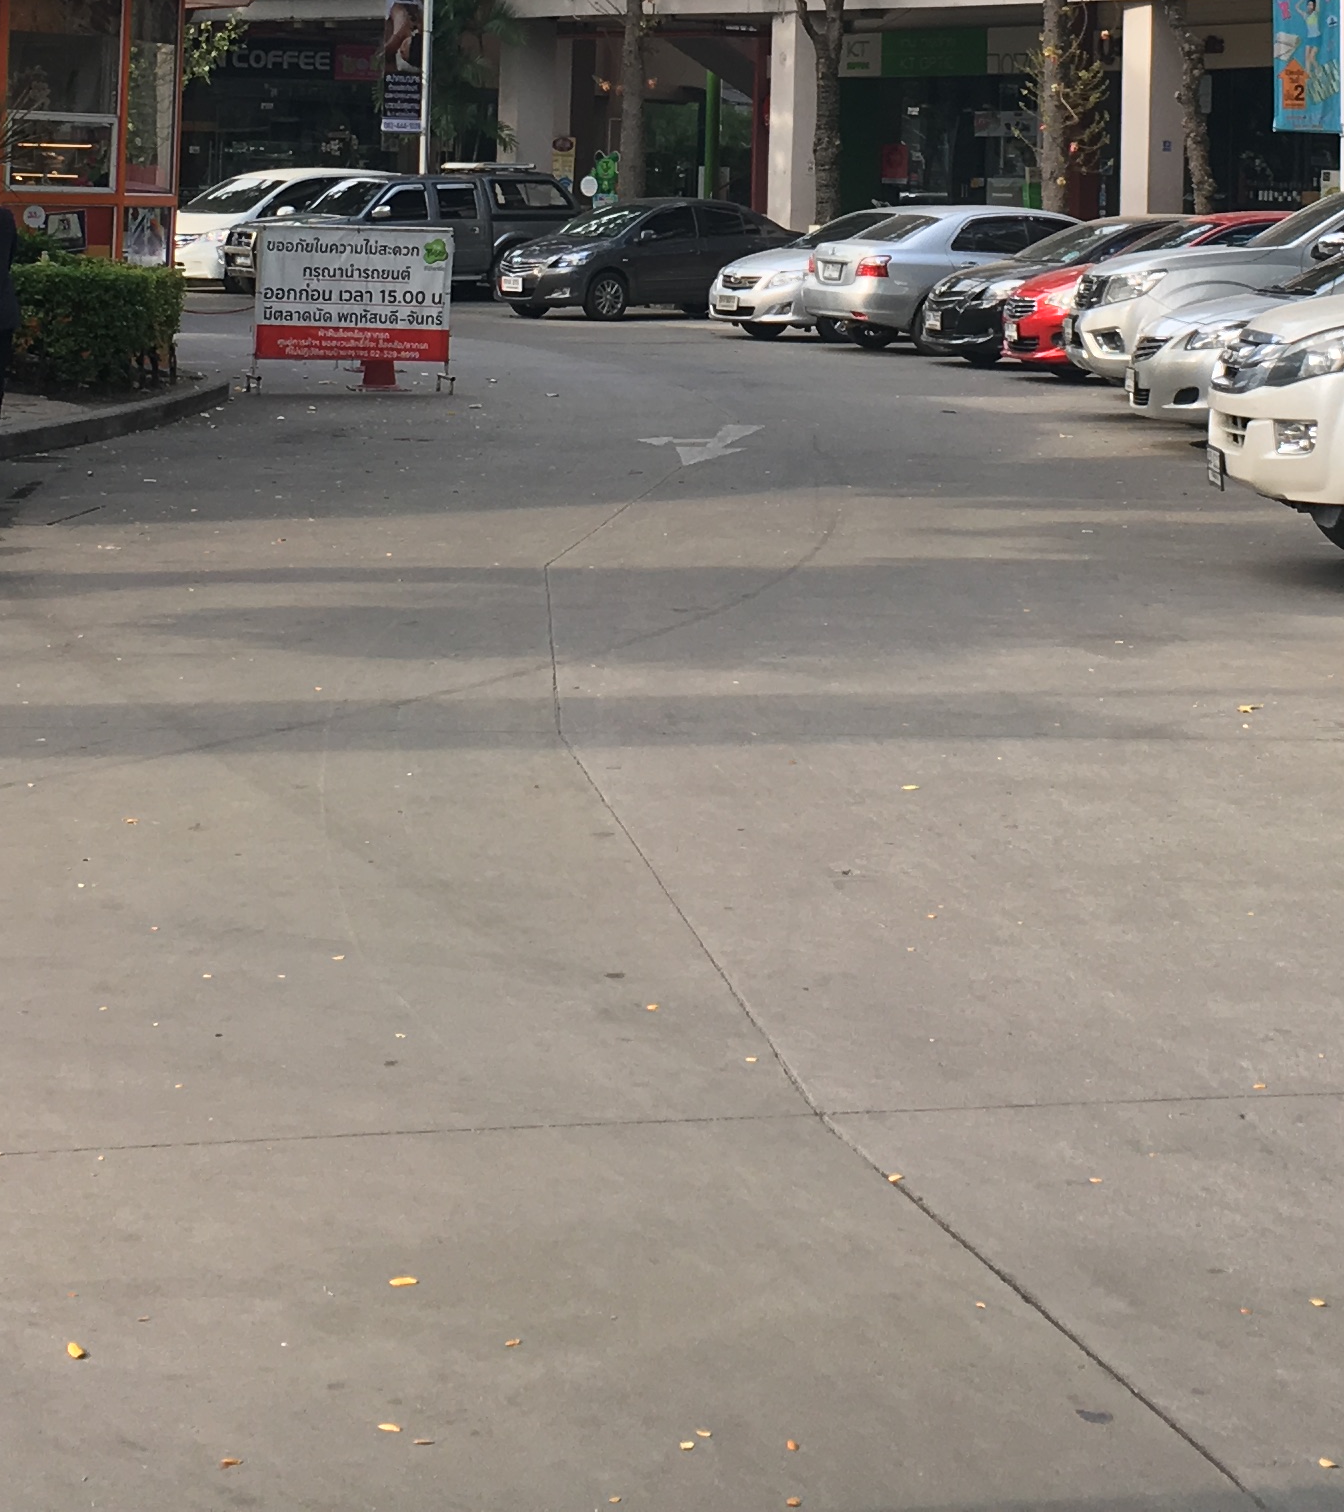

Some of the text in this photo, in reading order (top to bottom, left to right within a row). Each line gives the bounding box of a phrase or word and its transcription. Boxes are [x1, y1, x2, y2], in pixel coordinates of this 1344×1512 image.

[846, 40, 870, 57] KT
[231, 49, 331, 70] COFFEE
[1294, 84, 1305, 101] 2
[266, 237, 420, 257] ขออภัยในความไม่สะดวก
[302, 264, 411, 282] กรุณานำรถยนต์
[263, 283, 332, 301] ออกก่อน
[339, 289, 373, 303] เวลา
[380, 289, 426, 305] 15.00
[263, 307, 443, 327] มีตลาดนัด พฤหัสบดี-จันทร์
